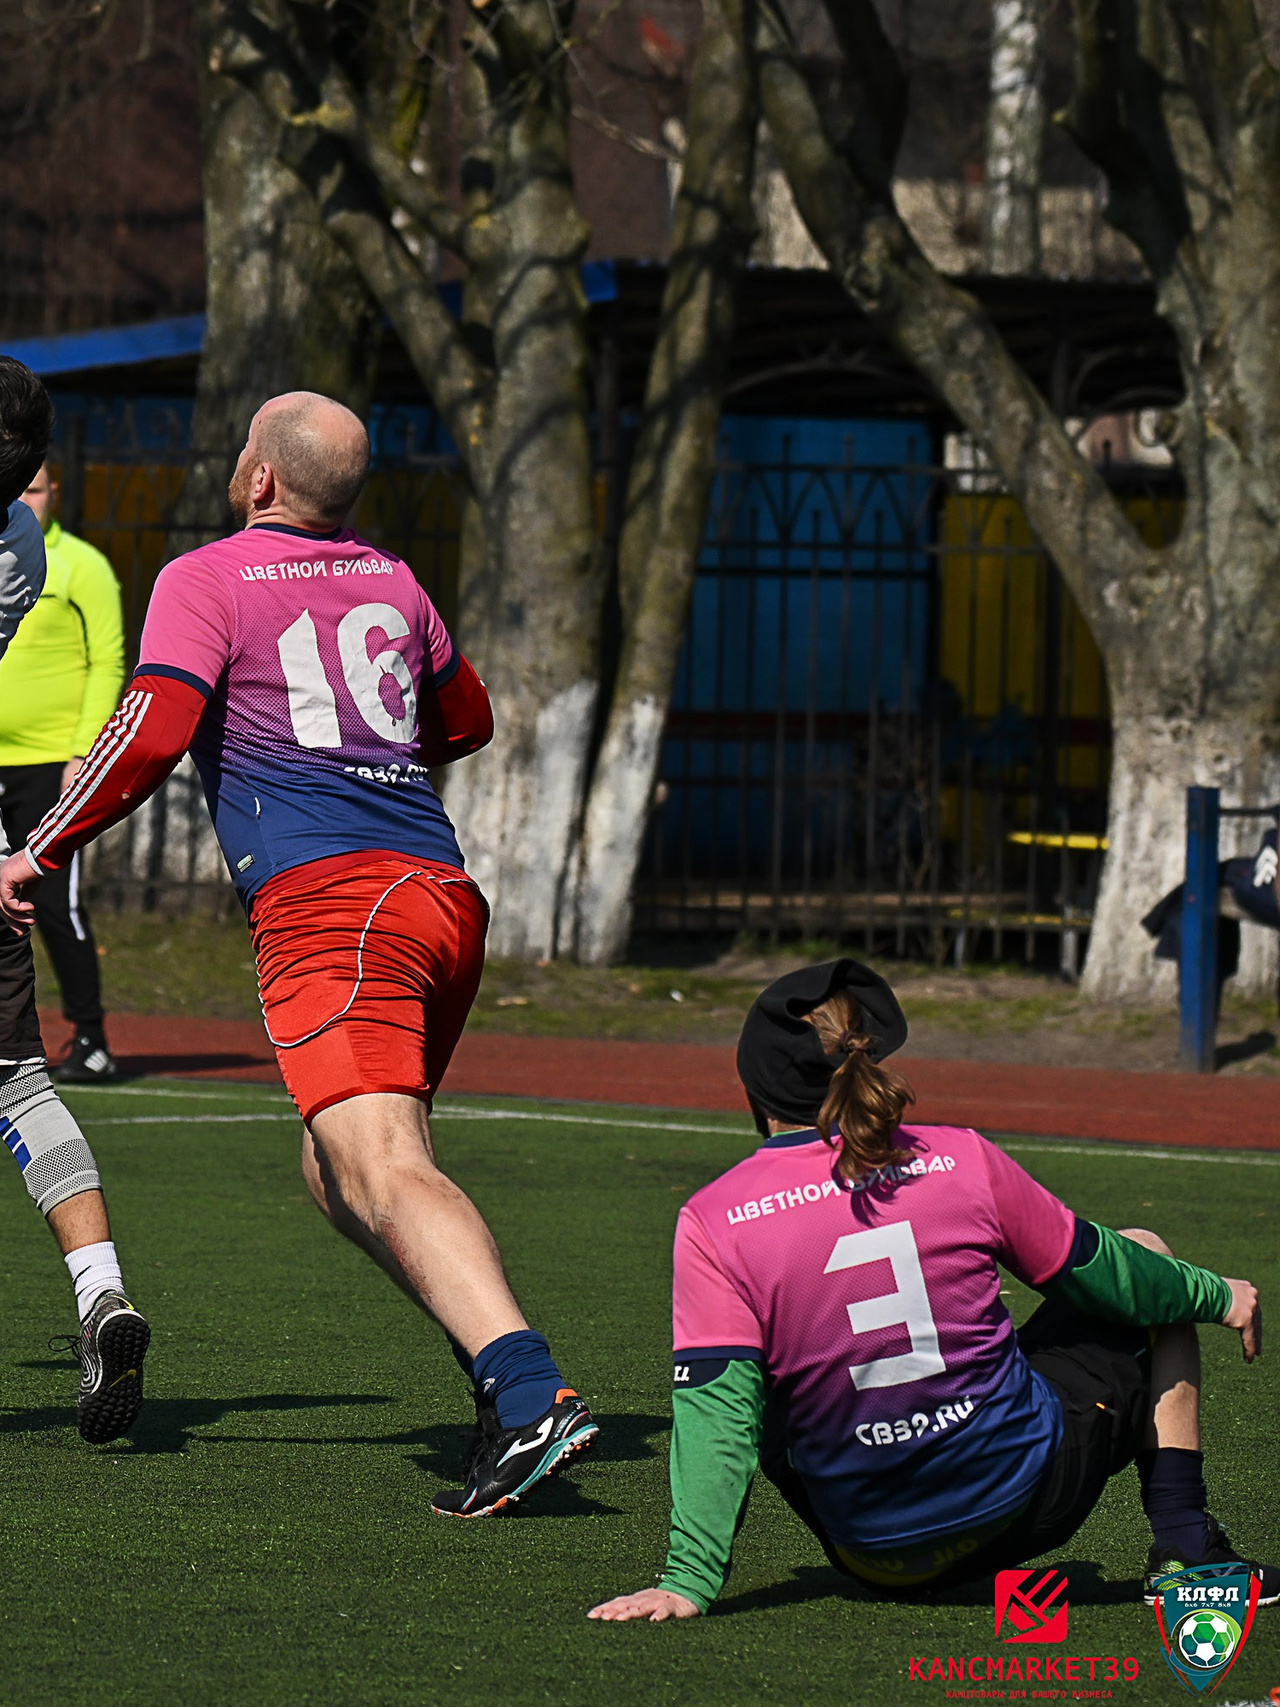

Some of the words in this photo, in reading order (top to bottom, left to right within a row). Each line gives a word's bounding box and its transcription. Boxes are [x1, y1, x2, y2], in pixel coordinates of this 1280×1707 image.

[239, 561, 328, 581] ЦВЕТНОЙ
[277, 602, 417, 748] 16
[726, 1179, 841, 1225] ЦВЕТНОЙ
[823, 1220, 946, 1391] 3
[855, 1395, 974, 1446] CB39.RU
